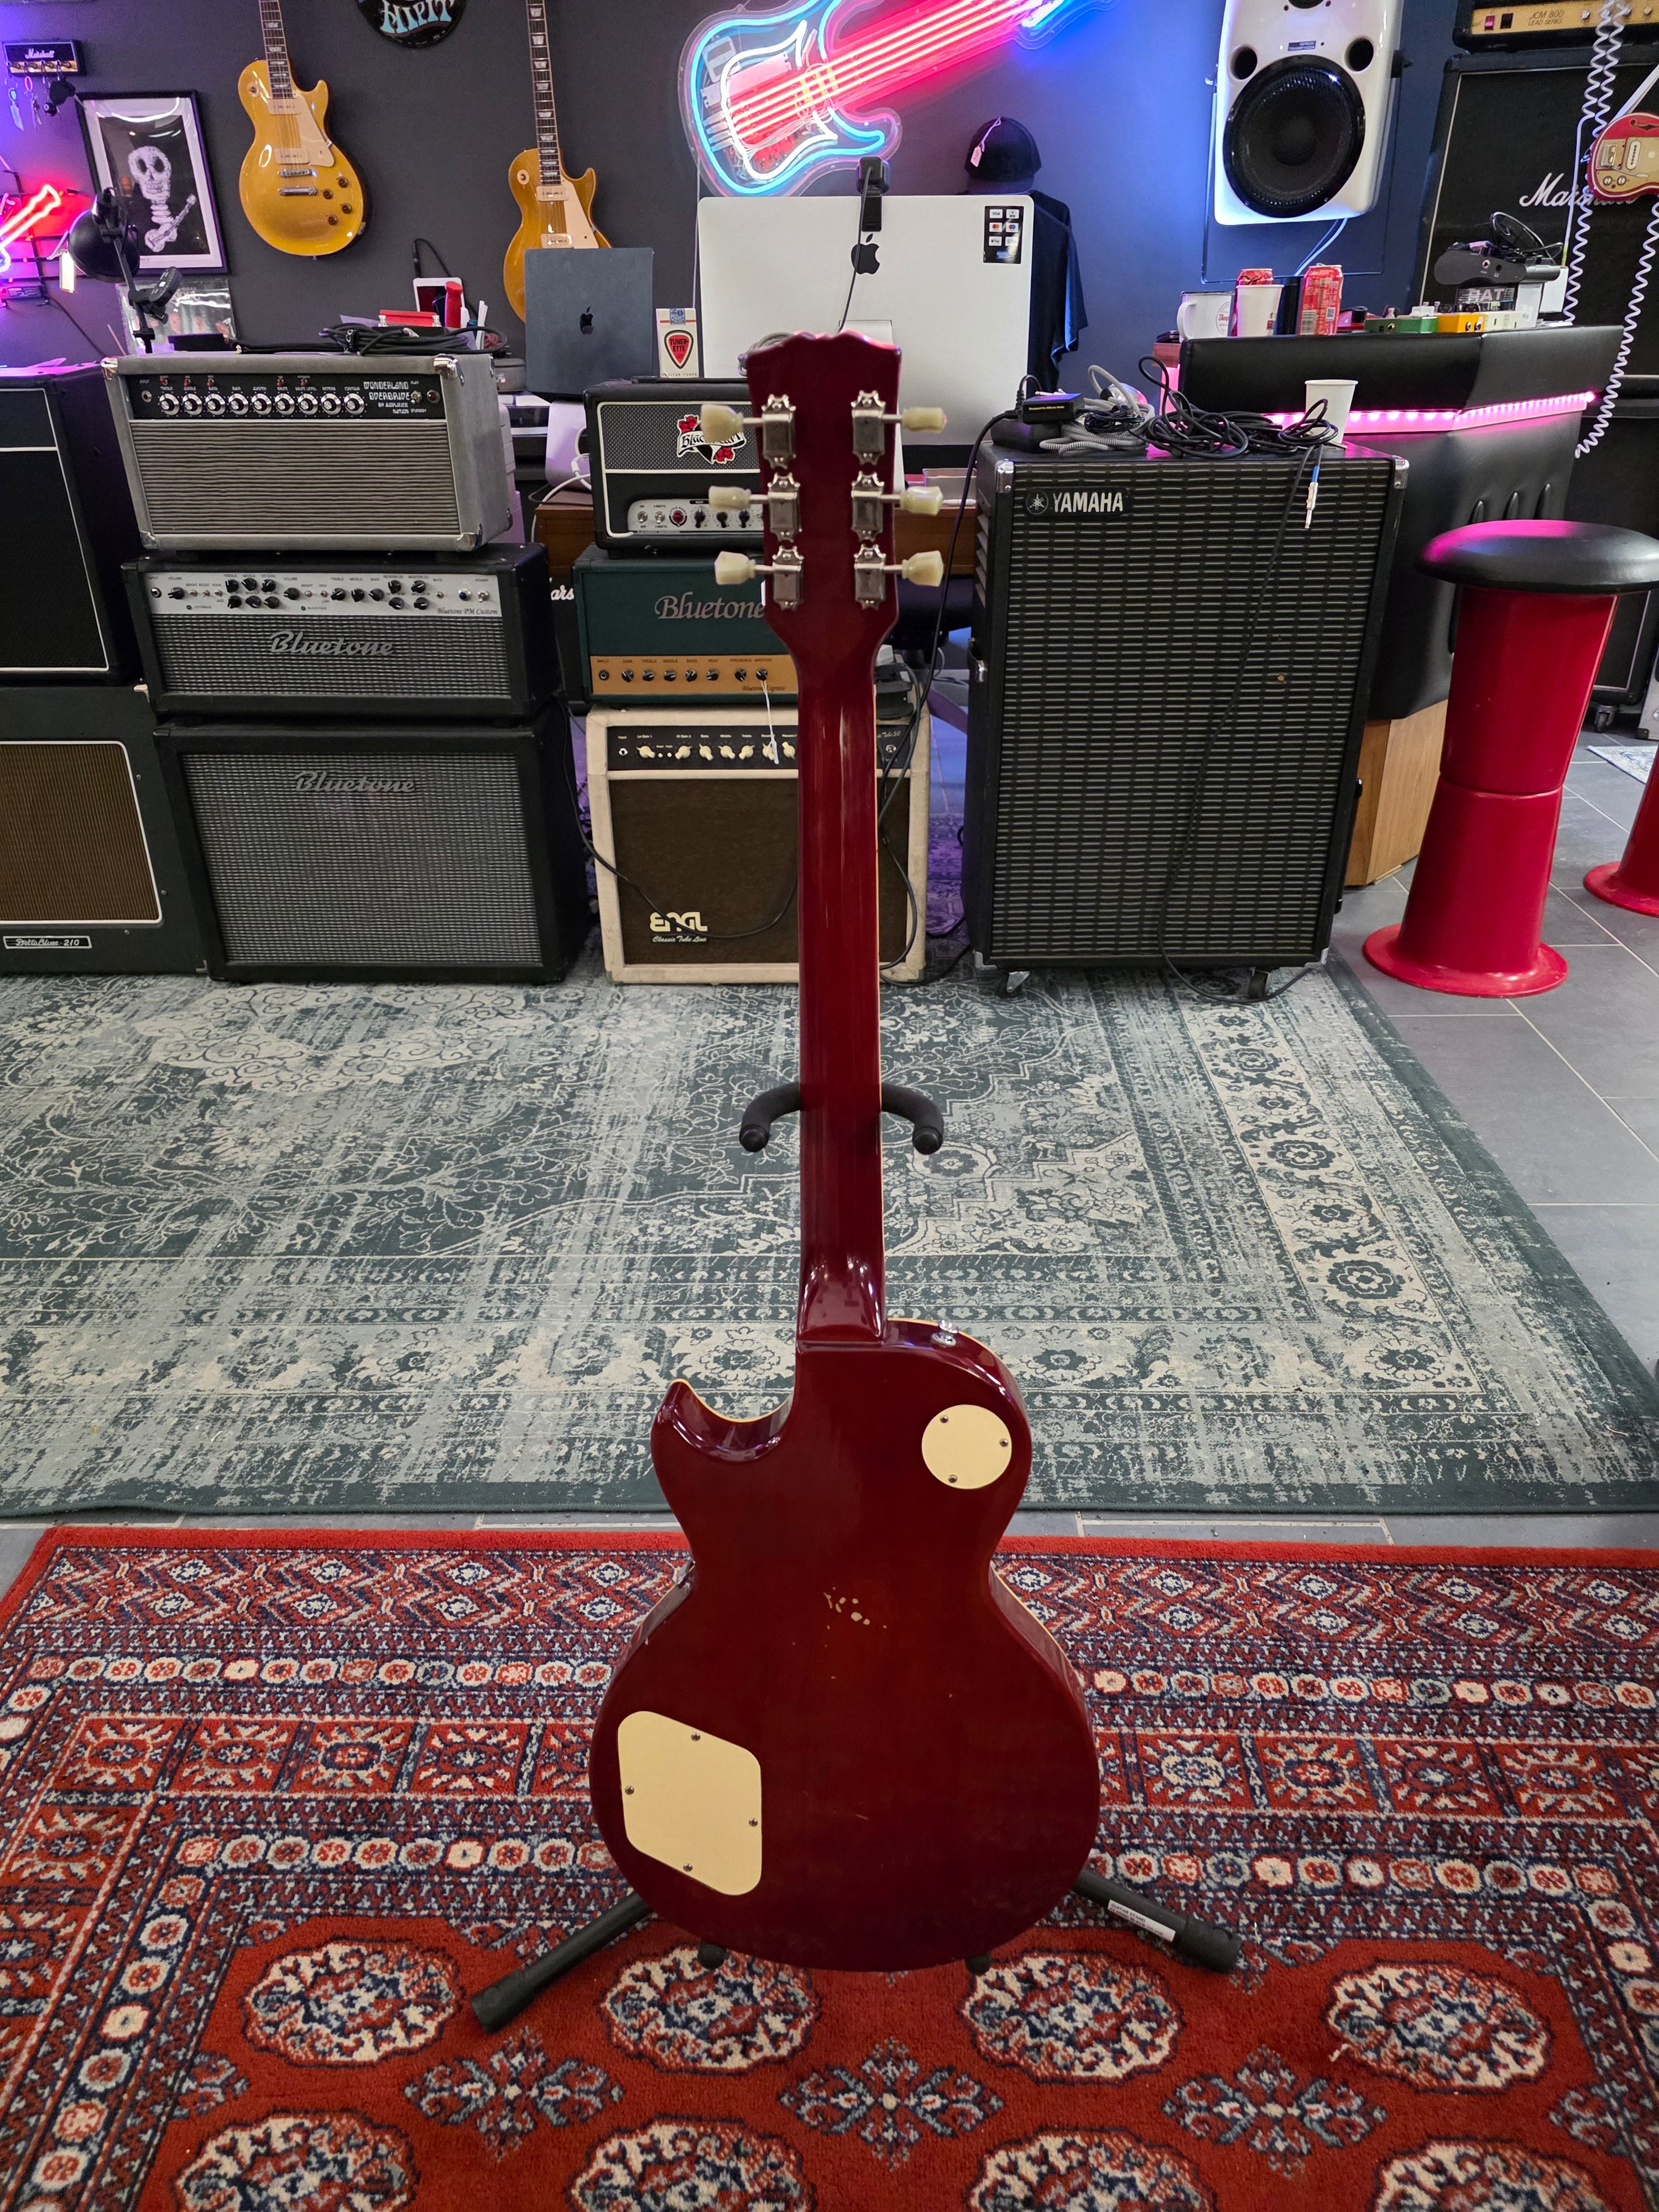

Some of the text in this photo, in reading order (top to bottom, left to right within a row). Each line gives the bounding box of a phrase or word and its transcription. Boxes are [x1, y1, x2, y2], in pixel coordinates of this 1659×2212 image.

[1529, 9, 1564, 20] JCM 800
[25, 48, 55, 59] Marshall
[1053, 492, 1123, 513] YAMAHA
[654, 591, 765, 619] Bluetone
[270, 630, 394, 655] Bluetone
[295, 770, 415, 792] Bluetone
[650, 911, 708, 932] ENGL
[1111, 1903, 1146, 1923] GUITAR STAND
